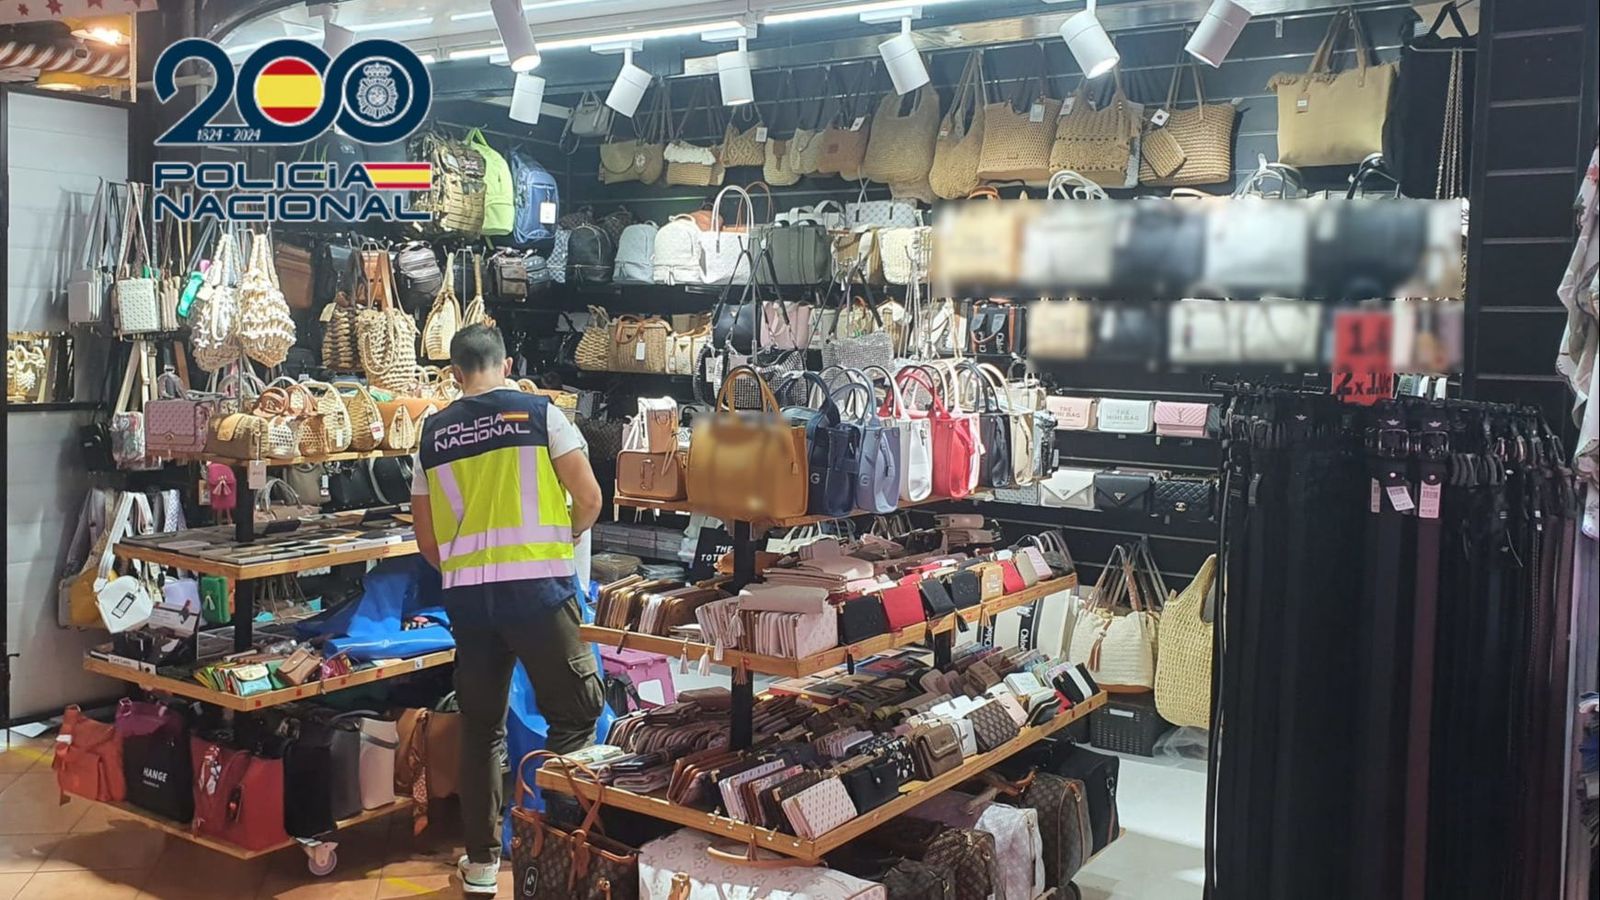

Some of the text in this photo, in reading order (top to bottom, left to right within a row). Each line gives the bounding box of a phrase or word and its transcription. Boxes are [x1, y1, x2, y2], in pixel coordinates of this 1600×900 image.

[434, 413, 505, 440] POLICIA
[434, 423, 531, 452] NACIONAL
[810, 473, 821, 484] G
[715, 545, 735, 553] THE
[701, 554, 723, 562] TOT
